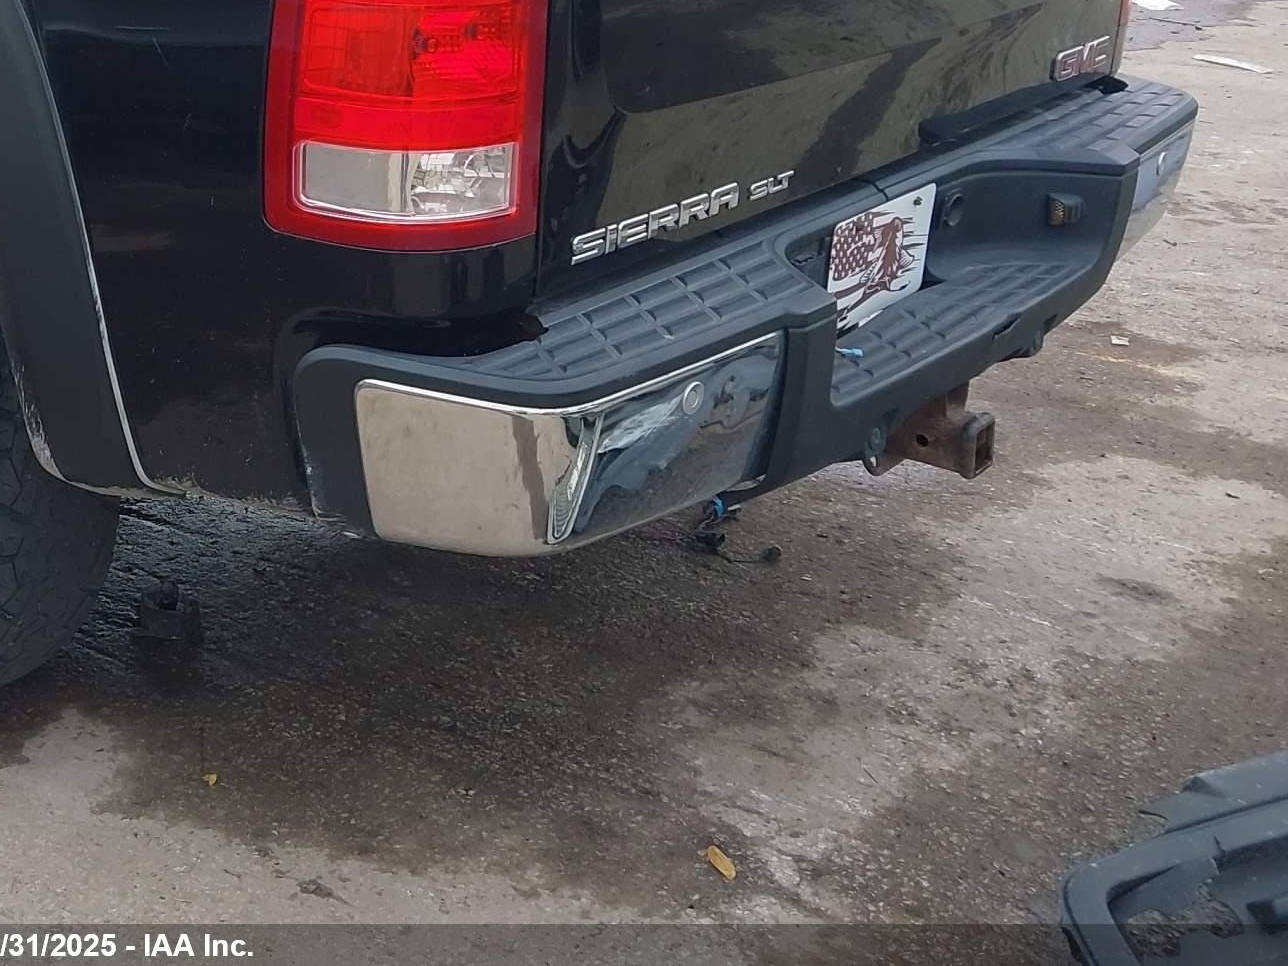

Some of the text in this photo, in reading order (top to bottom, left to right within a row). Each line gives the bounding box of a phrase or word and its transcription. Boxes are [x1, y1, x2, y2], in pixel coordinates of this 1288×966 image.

[1054, 35, 1110, 81] GMC
[571, 170, 795, 266] SIERRA SLT
